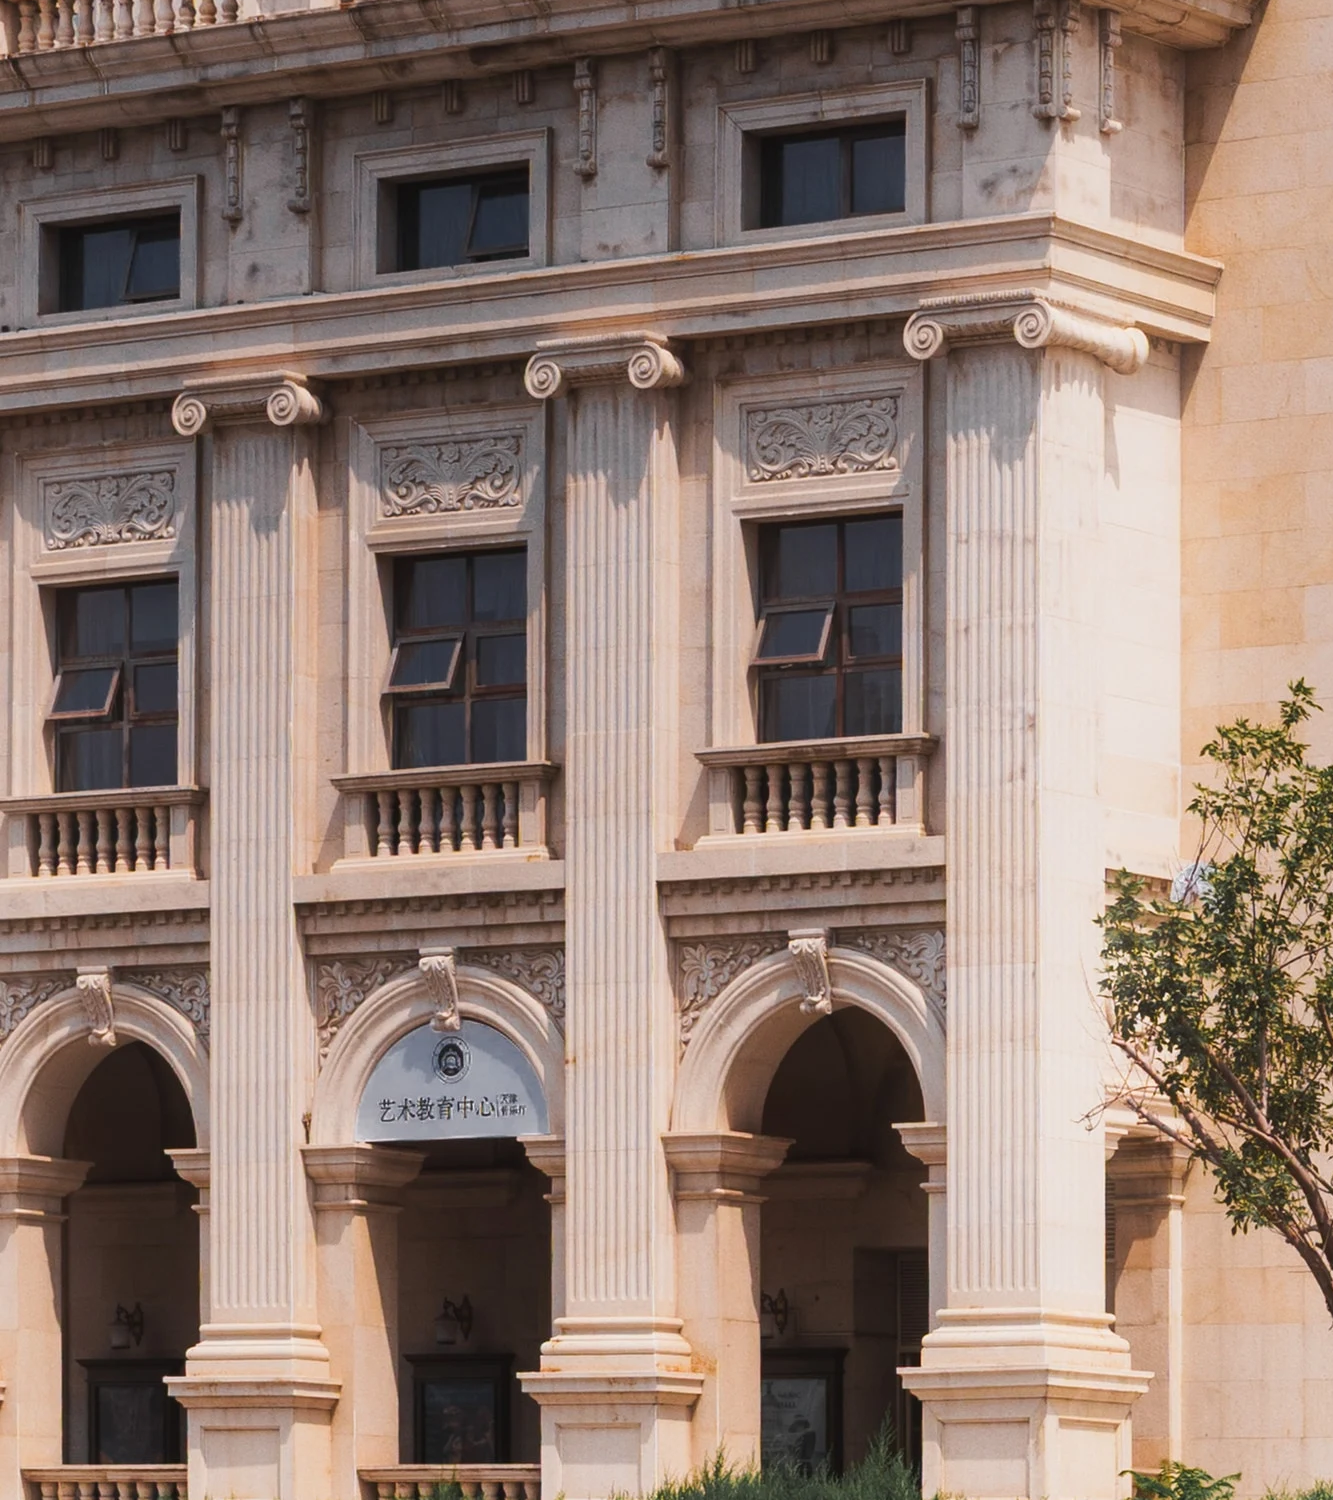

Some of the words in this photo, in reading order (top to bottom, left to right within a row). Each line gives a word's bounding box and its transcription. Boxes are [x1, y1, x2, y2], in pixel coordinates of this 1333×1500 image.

[379, 1095, 495, 1122] 艺术教育中心
